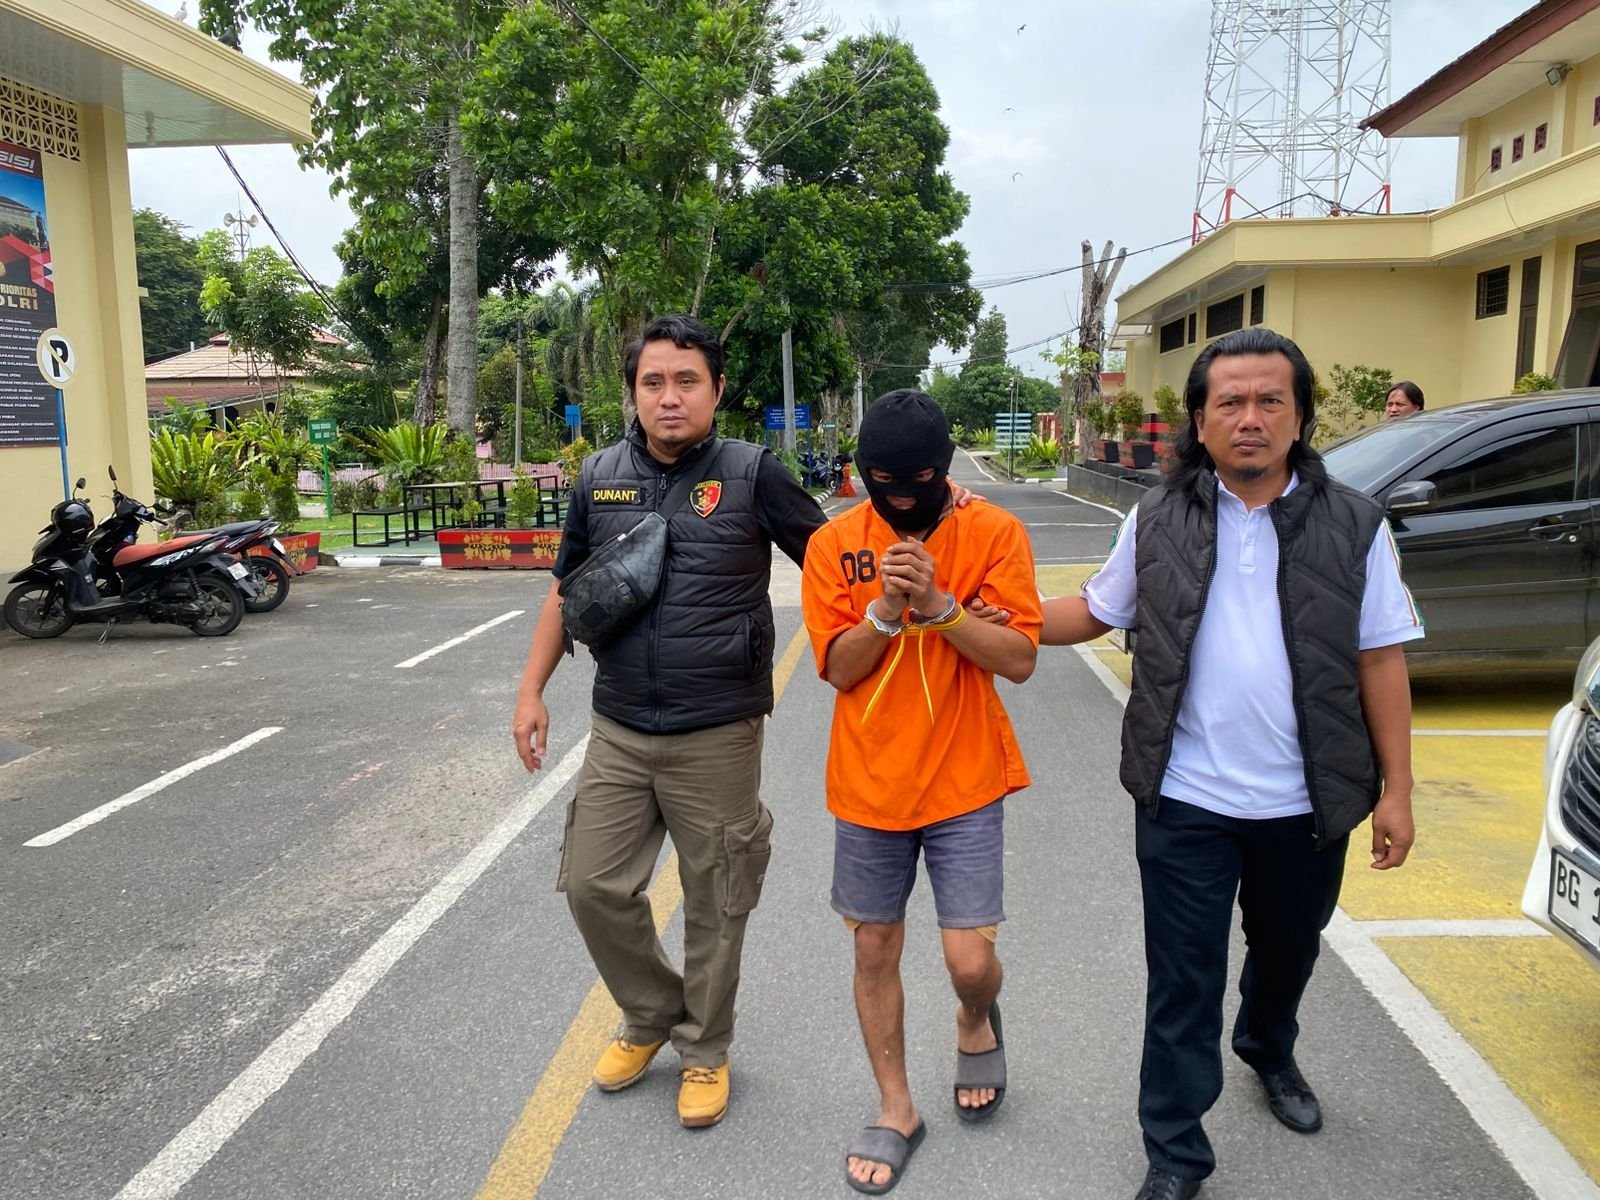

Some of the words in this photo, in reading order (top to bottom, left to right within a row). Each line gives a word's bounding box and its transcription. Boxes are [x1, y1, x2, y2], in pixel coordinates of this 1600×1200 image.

[593, 489, 638, 501] DUNANT
[840, 549, 876, 586] 08
[1557, 859, 1580, 910] BG
